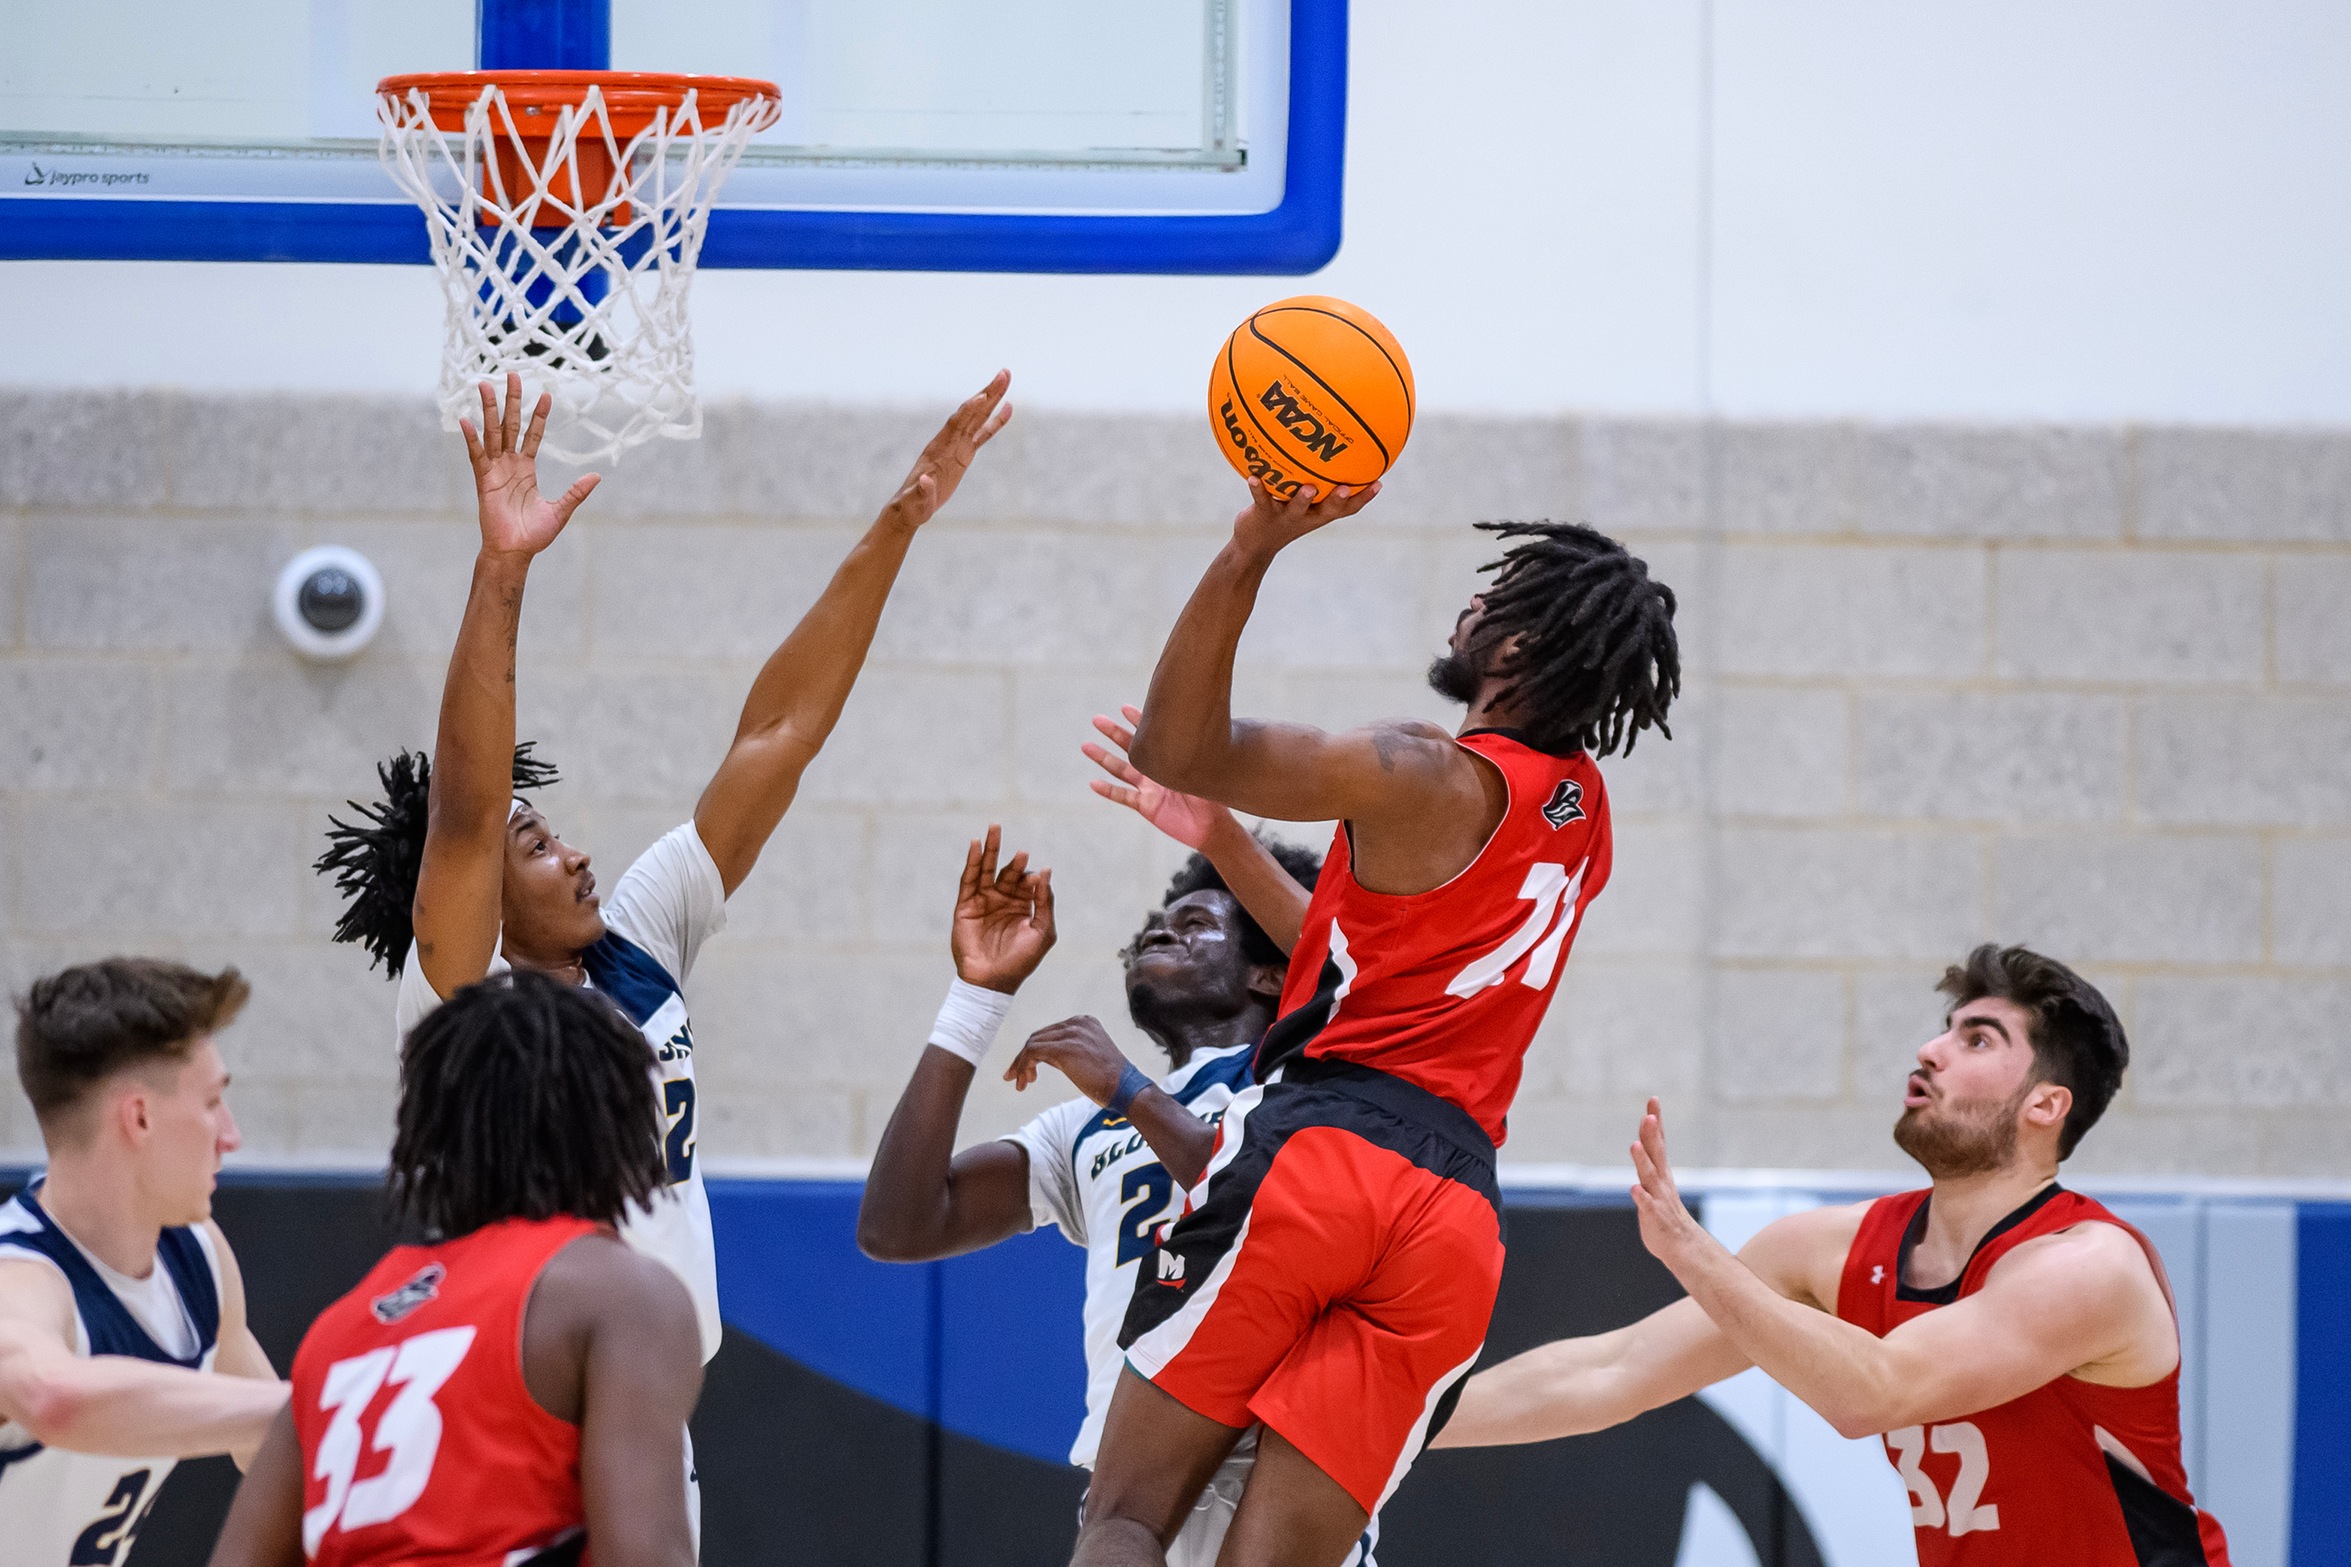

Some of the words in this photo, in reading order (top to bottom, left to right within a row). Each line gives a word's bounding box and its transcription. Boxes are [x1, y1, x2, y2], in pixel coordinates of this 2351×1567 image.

[50, 170, 99, 186] jaypro
[102, 172, 150, 186] sports
[1283, 374, 1301, 395] BALL
[1301, 395, 1323, 417] GAME
[1260, 379, 1349, 463] NCAA
[1325, 416, 1355, 444] OFFICIAL
[1115, 1160, 1183, 1270] 2
[1157, 1247, 1186, 1280] M
[302, 1324, 478, 1562] 33
[1887, 1420, 2001, 1538] 32
[67, 1466, 154, 1567] 2
